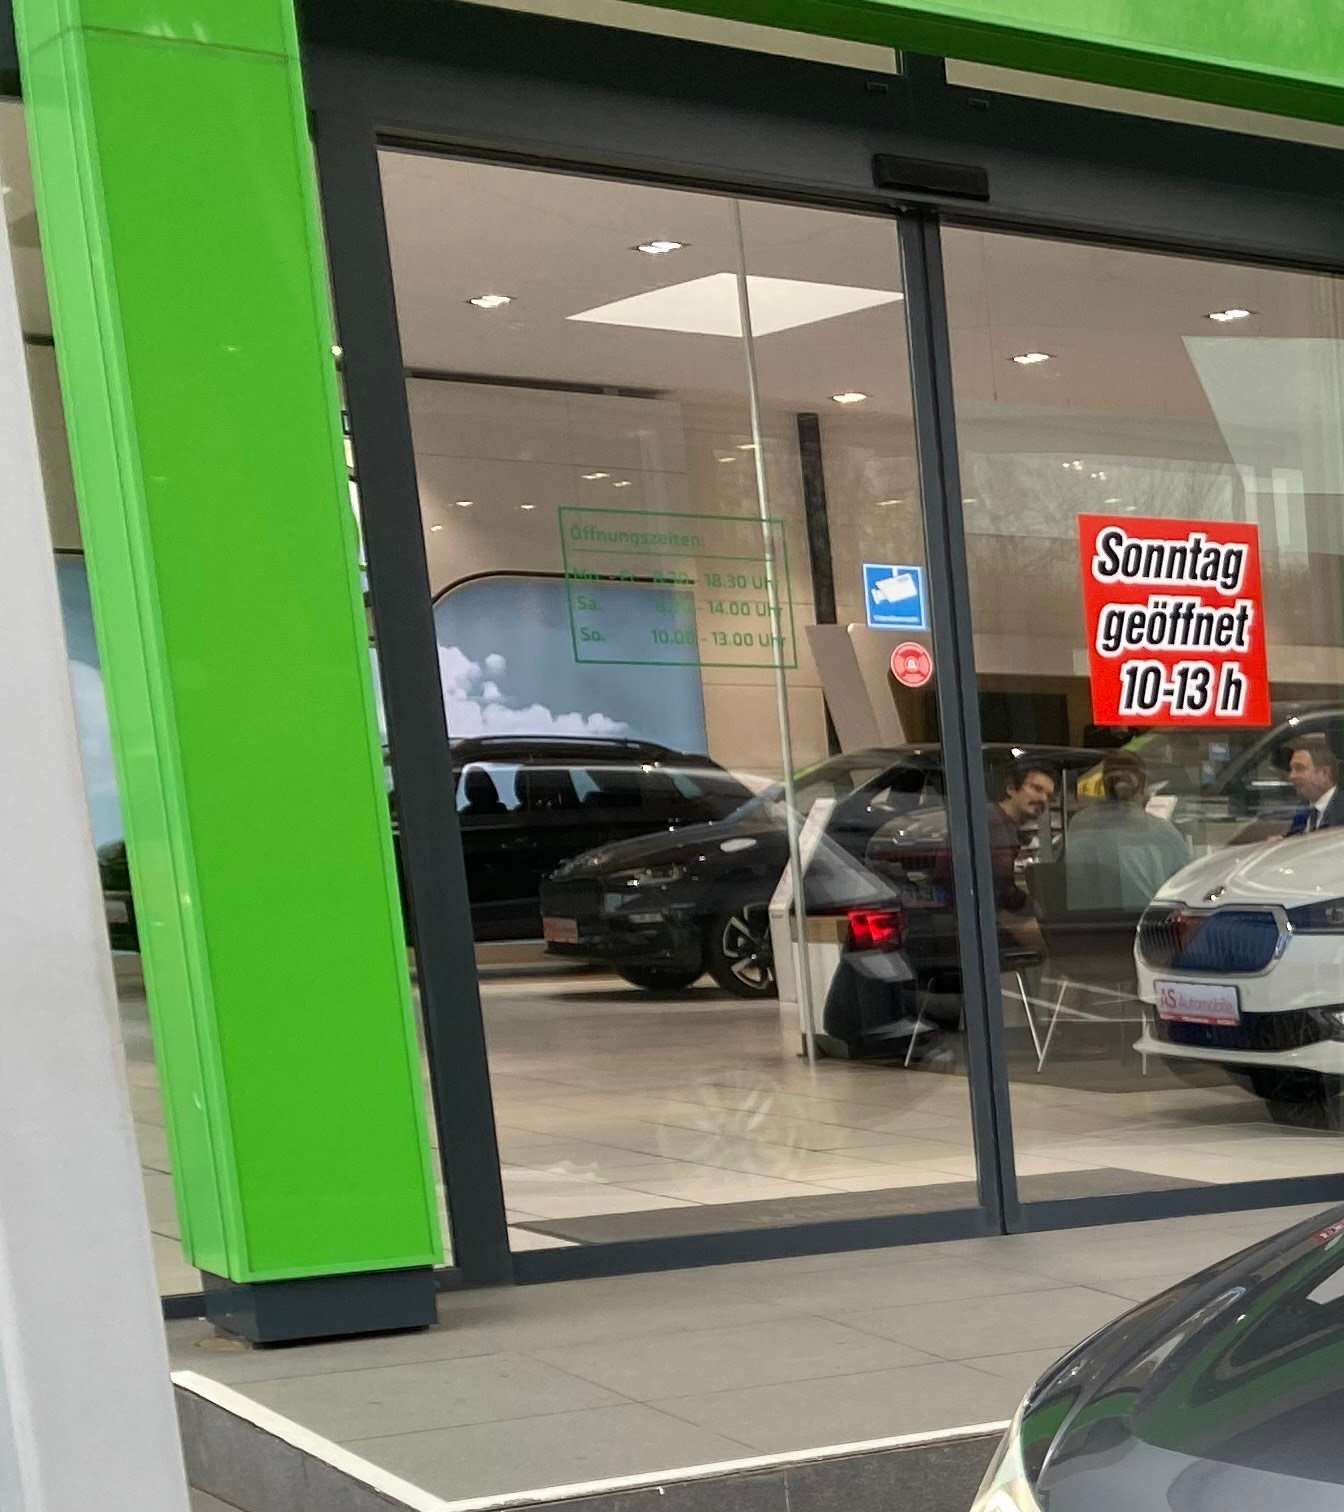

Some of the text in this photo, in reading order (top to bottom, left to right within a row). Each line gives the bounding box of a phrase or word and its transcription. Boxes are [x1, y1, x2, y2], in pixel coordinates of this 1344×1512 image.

[1098, 531, 1243, 590] Sonntag
[704, 573, 746, 589] 18.30
[707, 600, 750, 617] 14.00
[712, 631, 754, 647] 13.00
[1101, 600, 1248, 651] geöffnet
[1124, 665, 1242, 710] 10-13 h
